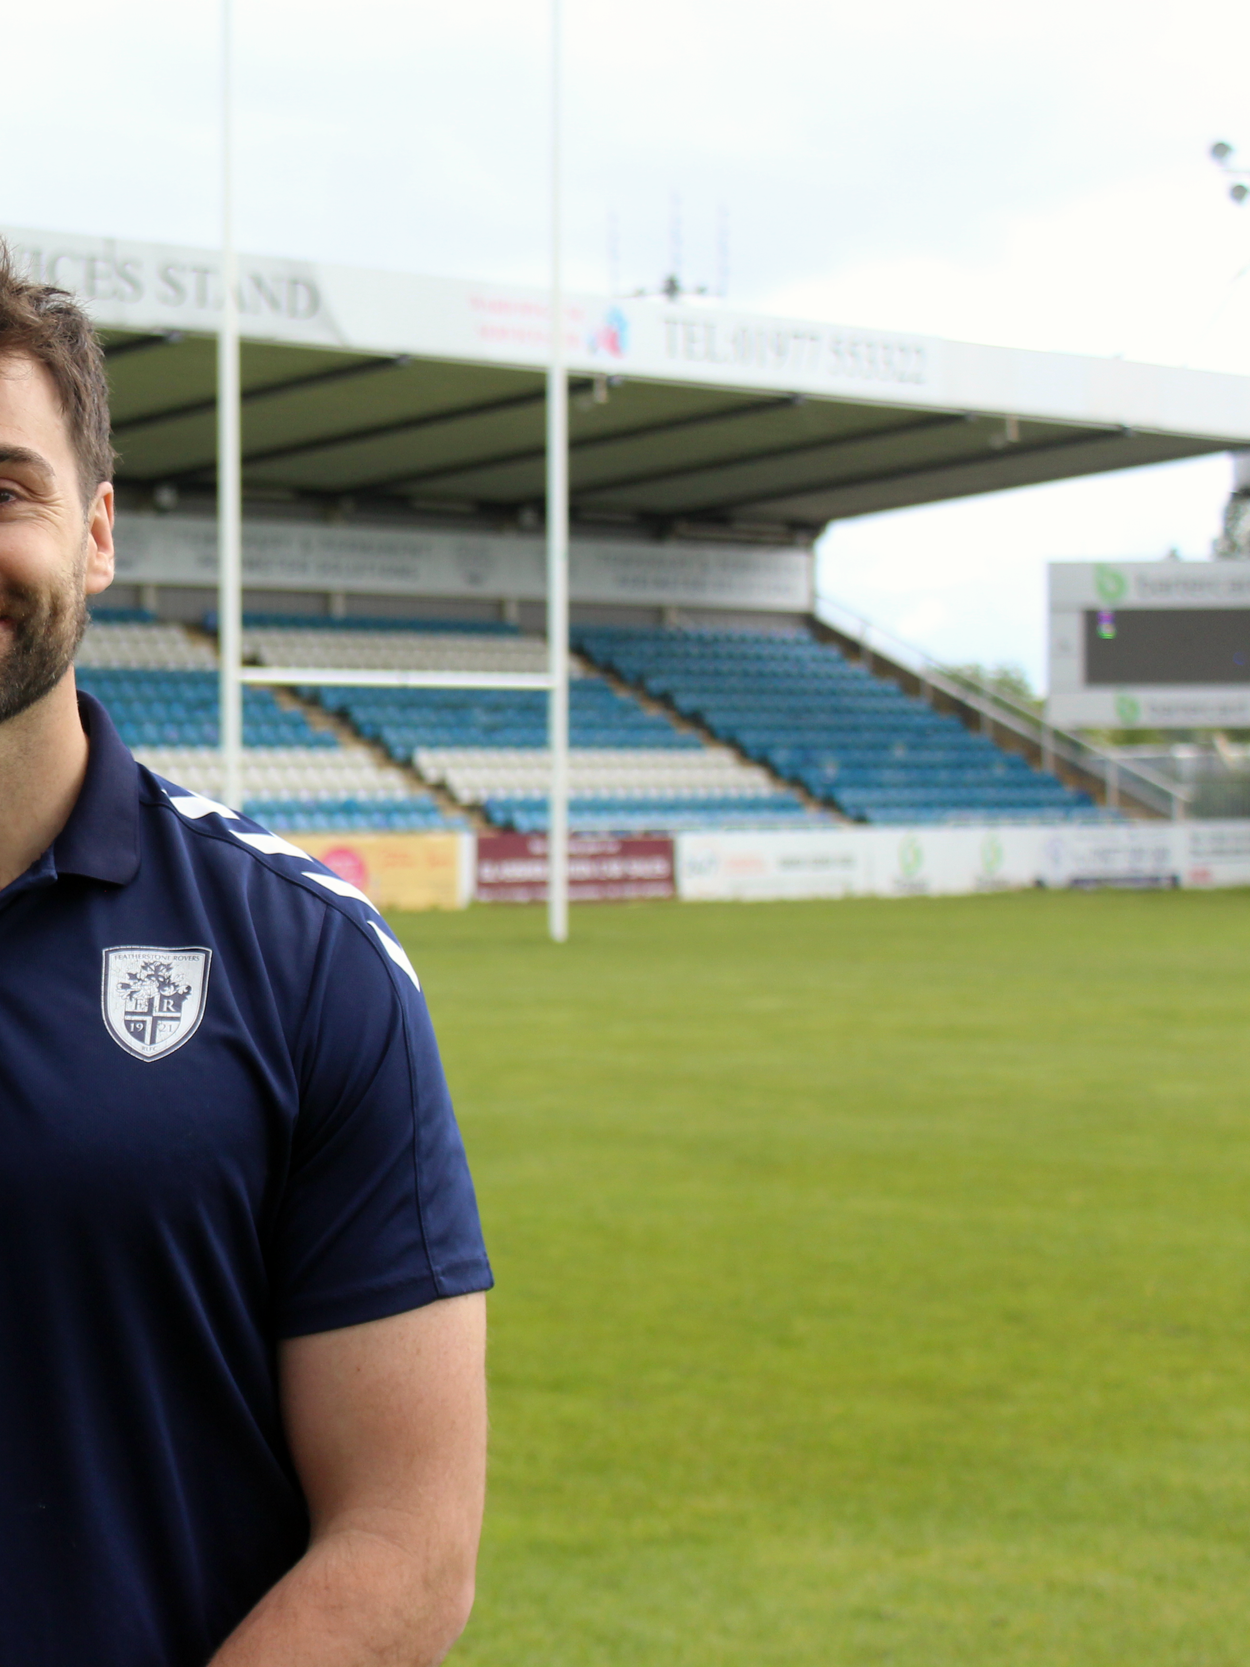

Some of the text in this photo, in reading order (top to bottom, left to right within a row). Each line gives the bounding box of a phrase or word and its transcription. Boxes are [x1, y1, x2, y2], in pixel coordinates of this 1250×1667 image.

[157, 258, 323, 320] STAND
[114, 953, 171, 961] FEATHERSTONE
[162, 998, 176, 1012] R
[130, 1022, 144, 1032] 19
